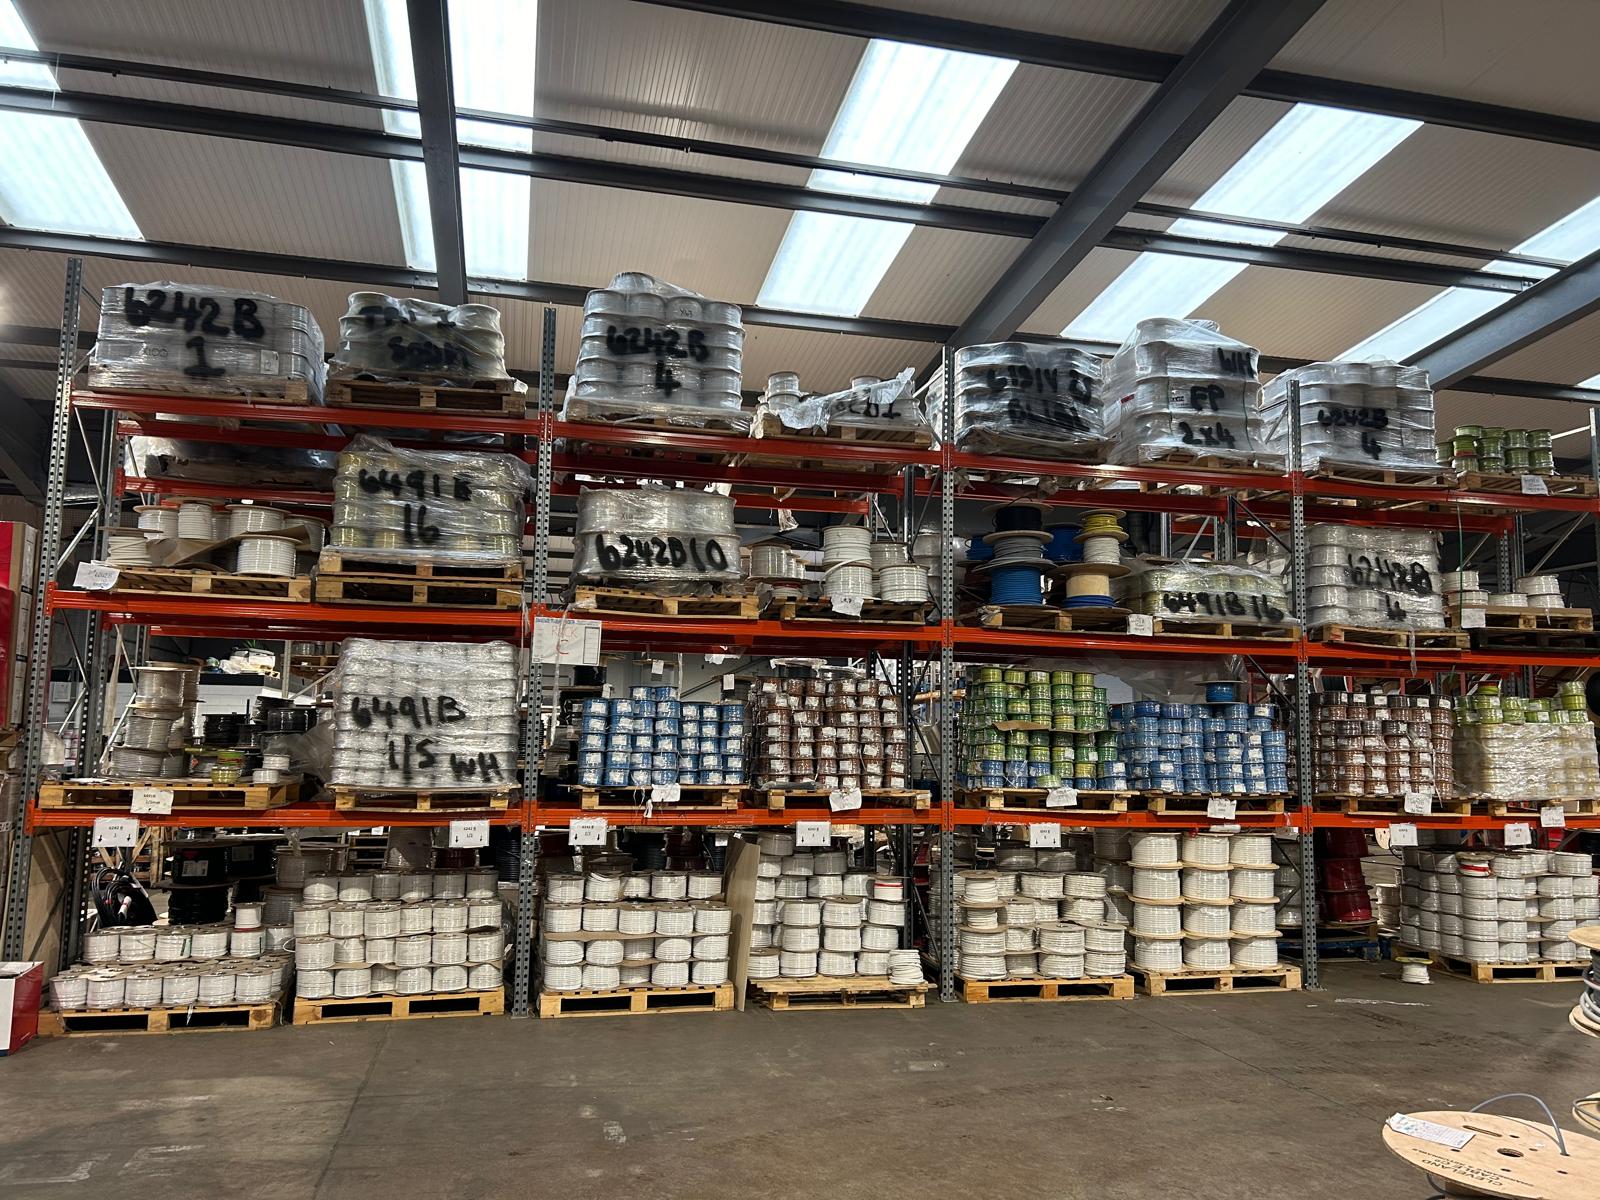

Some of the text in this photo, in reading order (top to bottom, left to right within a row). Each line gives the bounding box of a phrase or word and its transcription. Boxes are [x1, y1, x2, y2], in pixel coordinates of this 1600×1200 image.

[183, 335, 226, 377] 1
[606, 325, 710, 363] 6242B
[655, 360, 682, 398] 4
[1217, 347, 1256, 378] WH
[404, 504, 440, 544] 16
[351, 695, 466, 728] 6491B
[1421, 1159, 1504, 1187] CLEVELAND
[1454, 1162, 1501, 1181] CABLE
